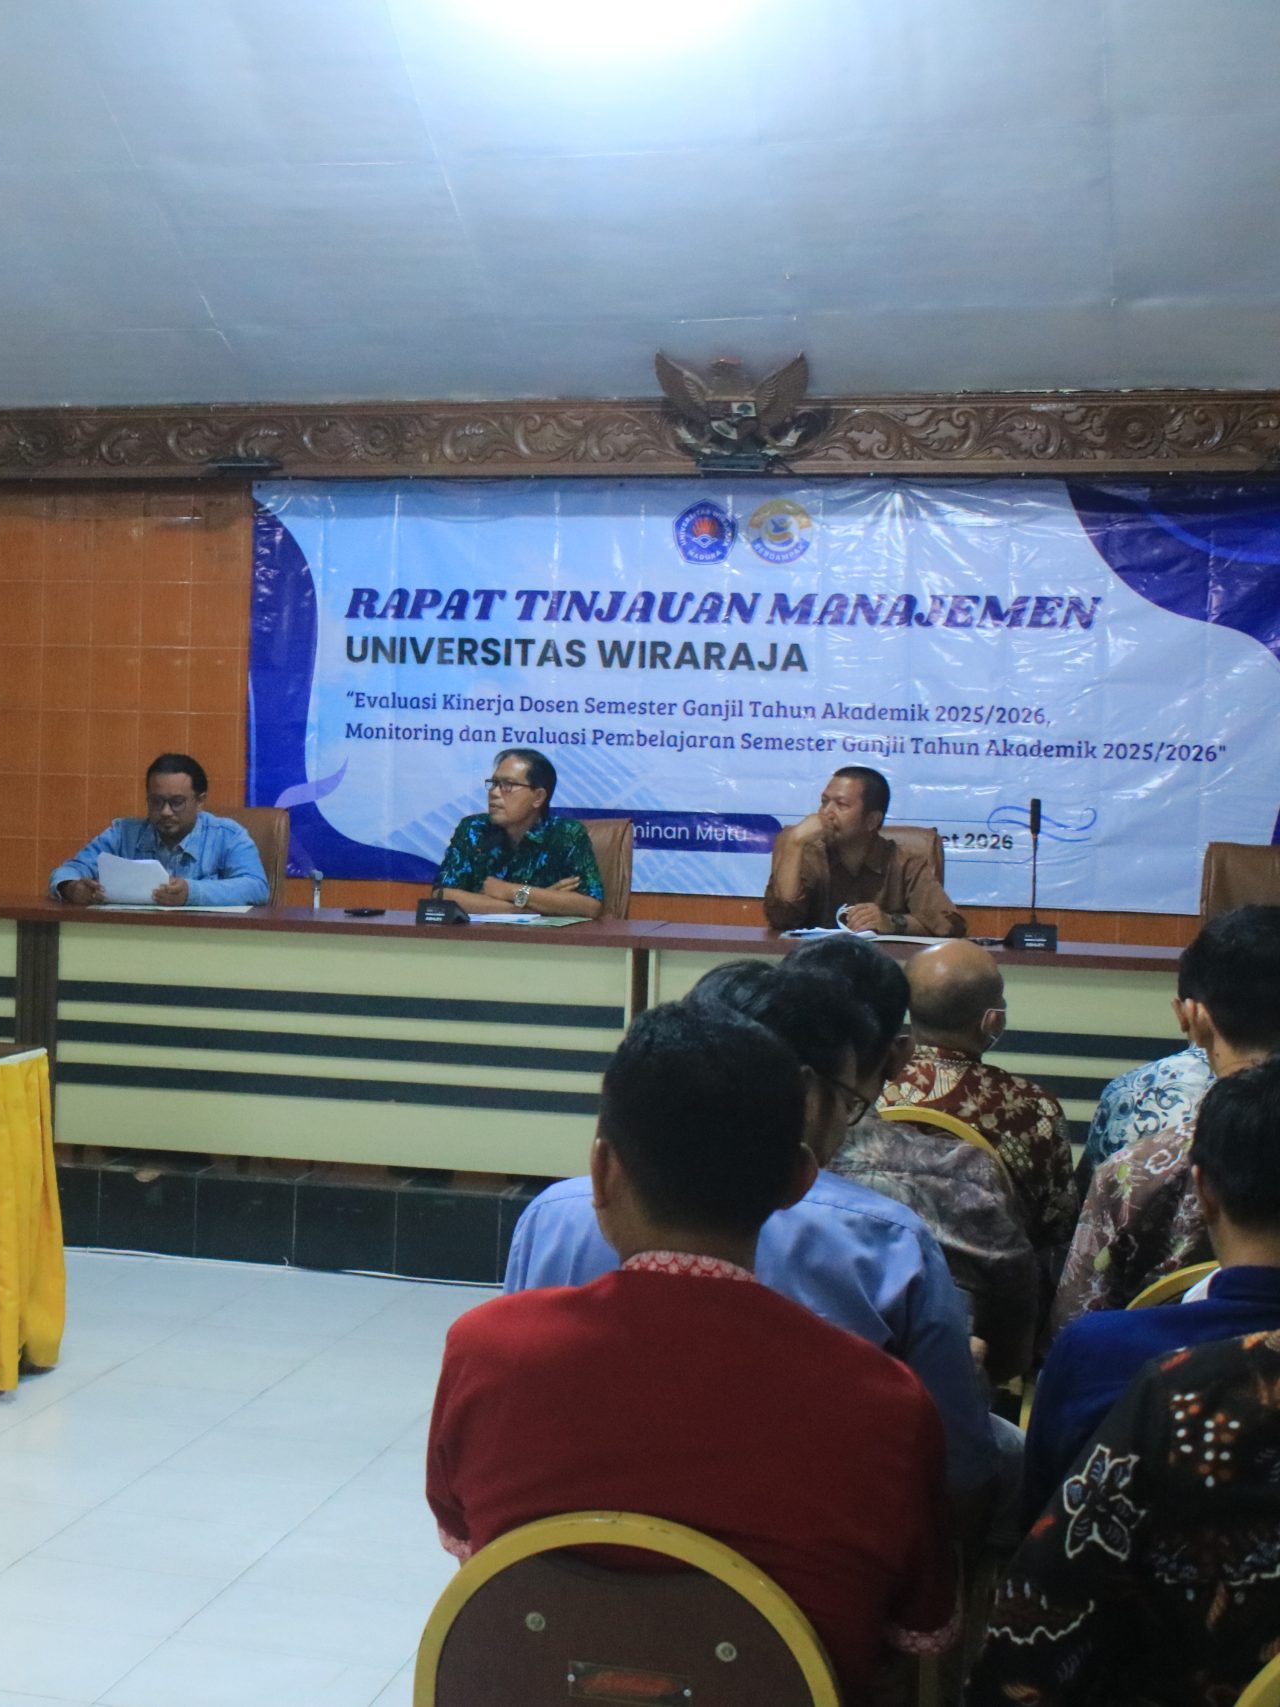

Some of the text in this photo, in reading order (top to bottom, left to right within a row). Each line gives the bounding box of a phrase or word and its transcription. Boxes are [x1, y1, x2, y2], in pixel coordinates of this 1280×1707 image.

[344, 587, 1102, 631] RAPAT TINJAUAN MANAJEMEN
[346, 635, 809, 672] UNIVERSITAS WIRARAJA
[441, 694, 515, 716] Kinerja
[519, 696, 580, 713] Dosen
[584, 697, 678, 716] Semester
[682, 699, 744, 722] Ganjil
[748, 700, 817, 720] Tahun
[821, 702, 930, 723] Akademik
[935, 704, 1051, 728] 2025/2026,
[344, 723, 455, 746] Monitoring
[459, 725, 497, 743] dan
[502, 727, 587, 746] Evaluasi
[591, 729, 736, 752] Pembelajaran
[740, 732, 837, 752] Semester
[910, 737, 980, 756] Tahun
[984, 738, 1097, 760] Akademik
[633, 821, 747, 842] minan Mutu
[940, 832, 1014, 850] et 2026
